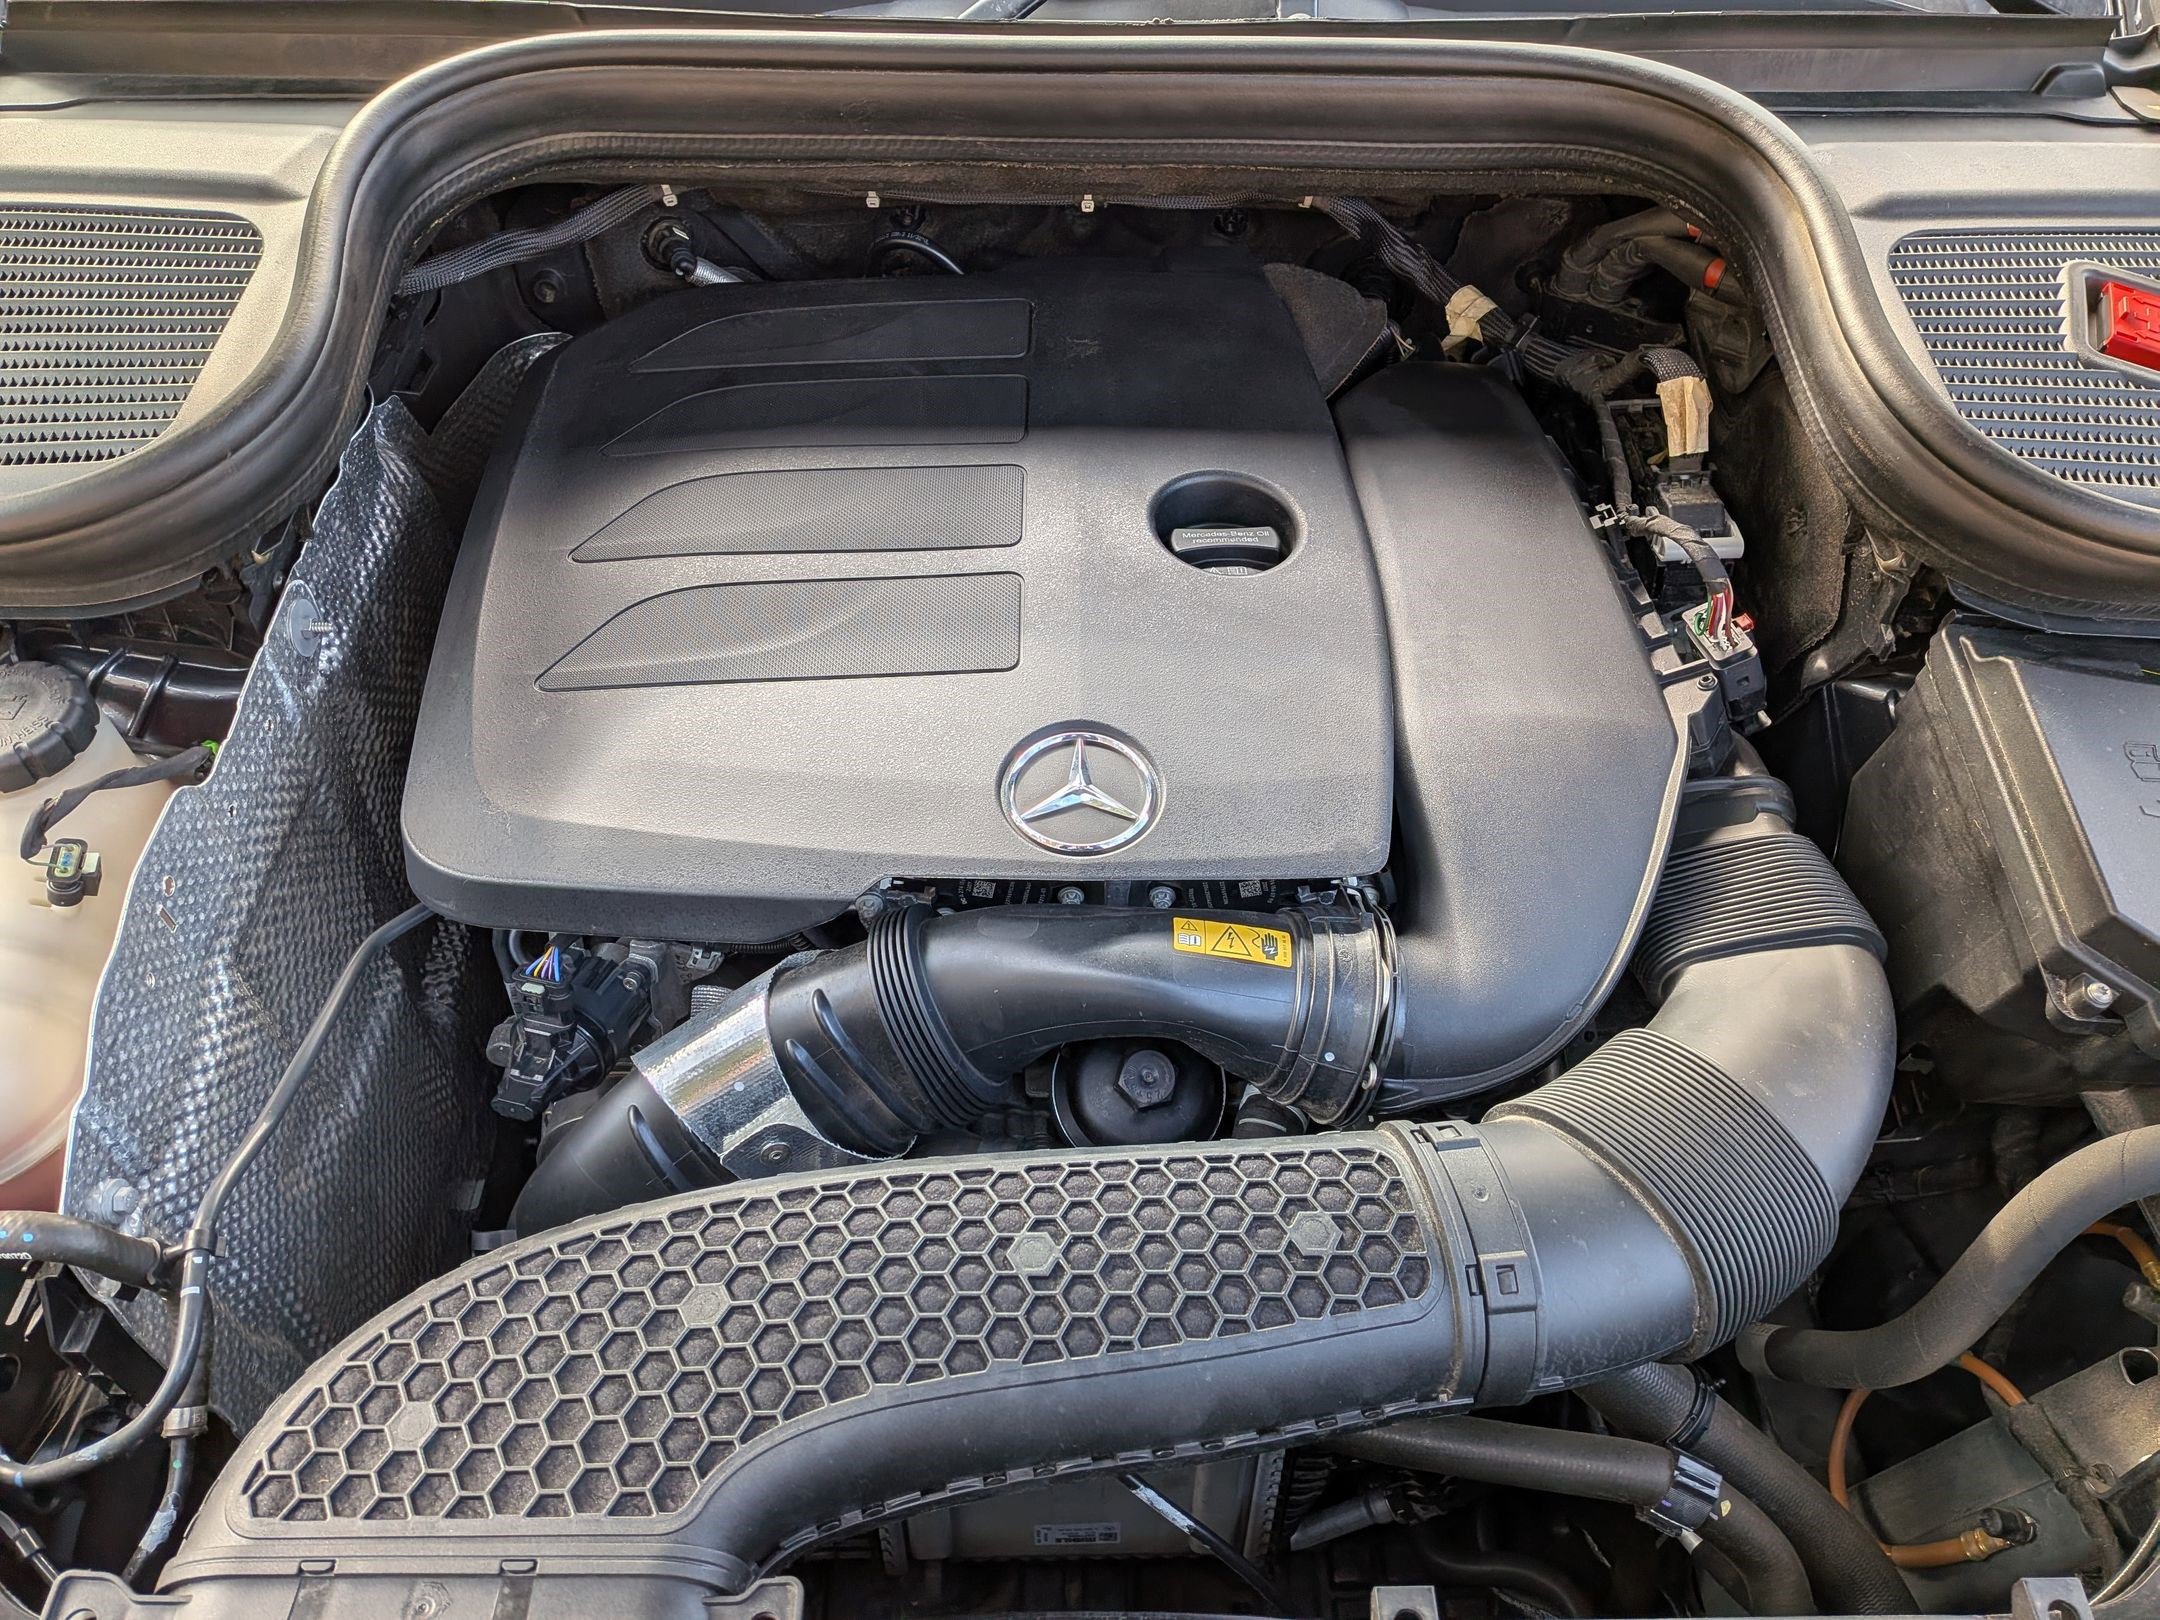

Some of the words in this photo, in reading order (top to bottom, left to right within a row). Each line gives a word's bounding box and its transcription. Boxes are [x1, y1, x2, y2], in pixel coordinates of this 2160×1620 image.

[1182, 530, 1254, 539] Mercedes-Benz
[1192, 536, 1259, 544] recommended
[16, 716, 48, 739] HEISS
